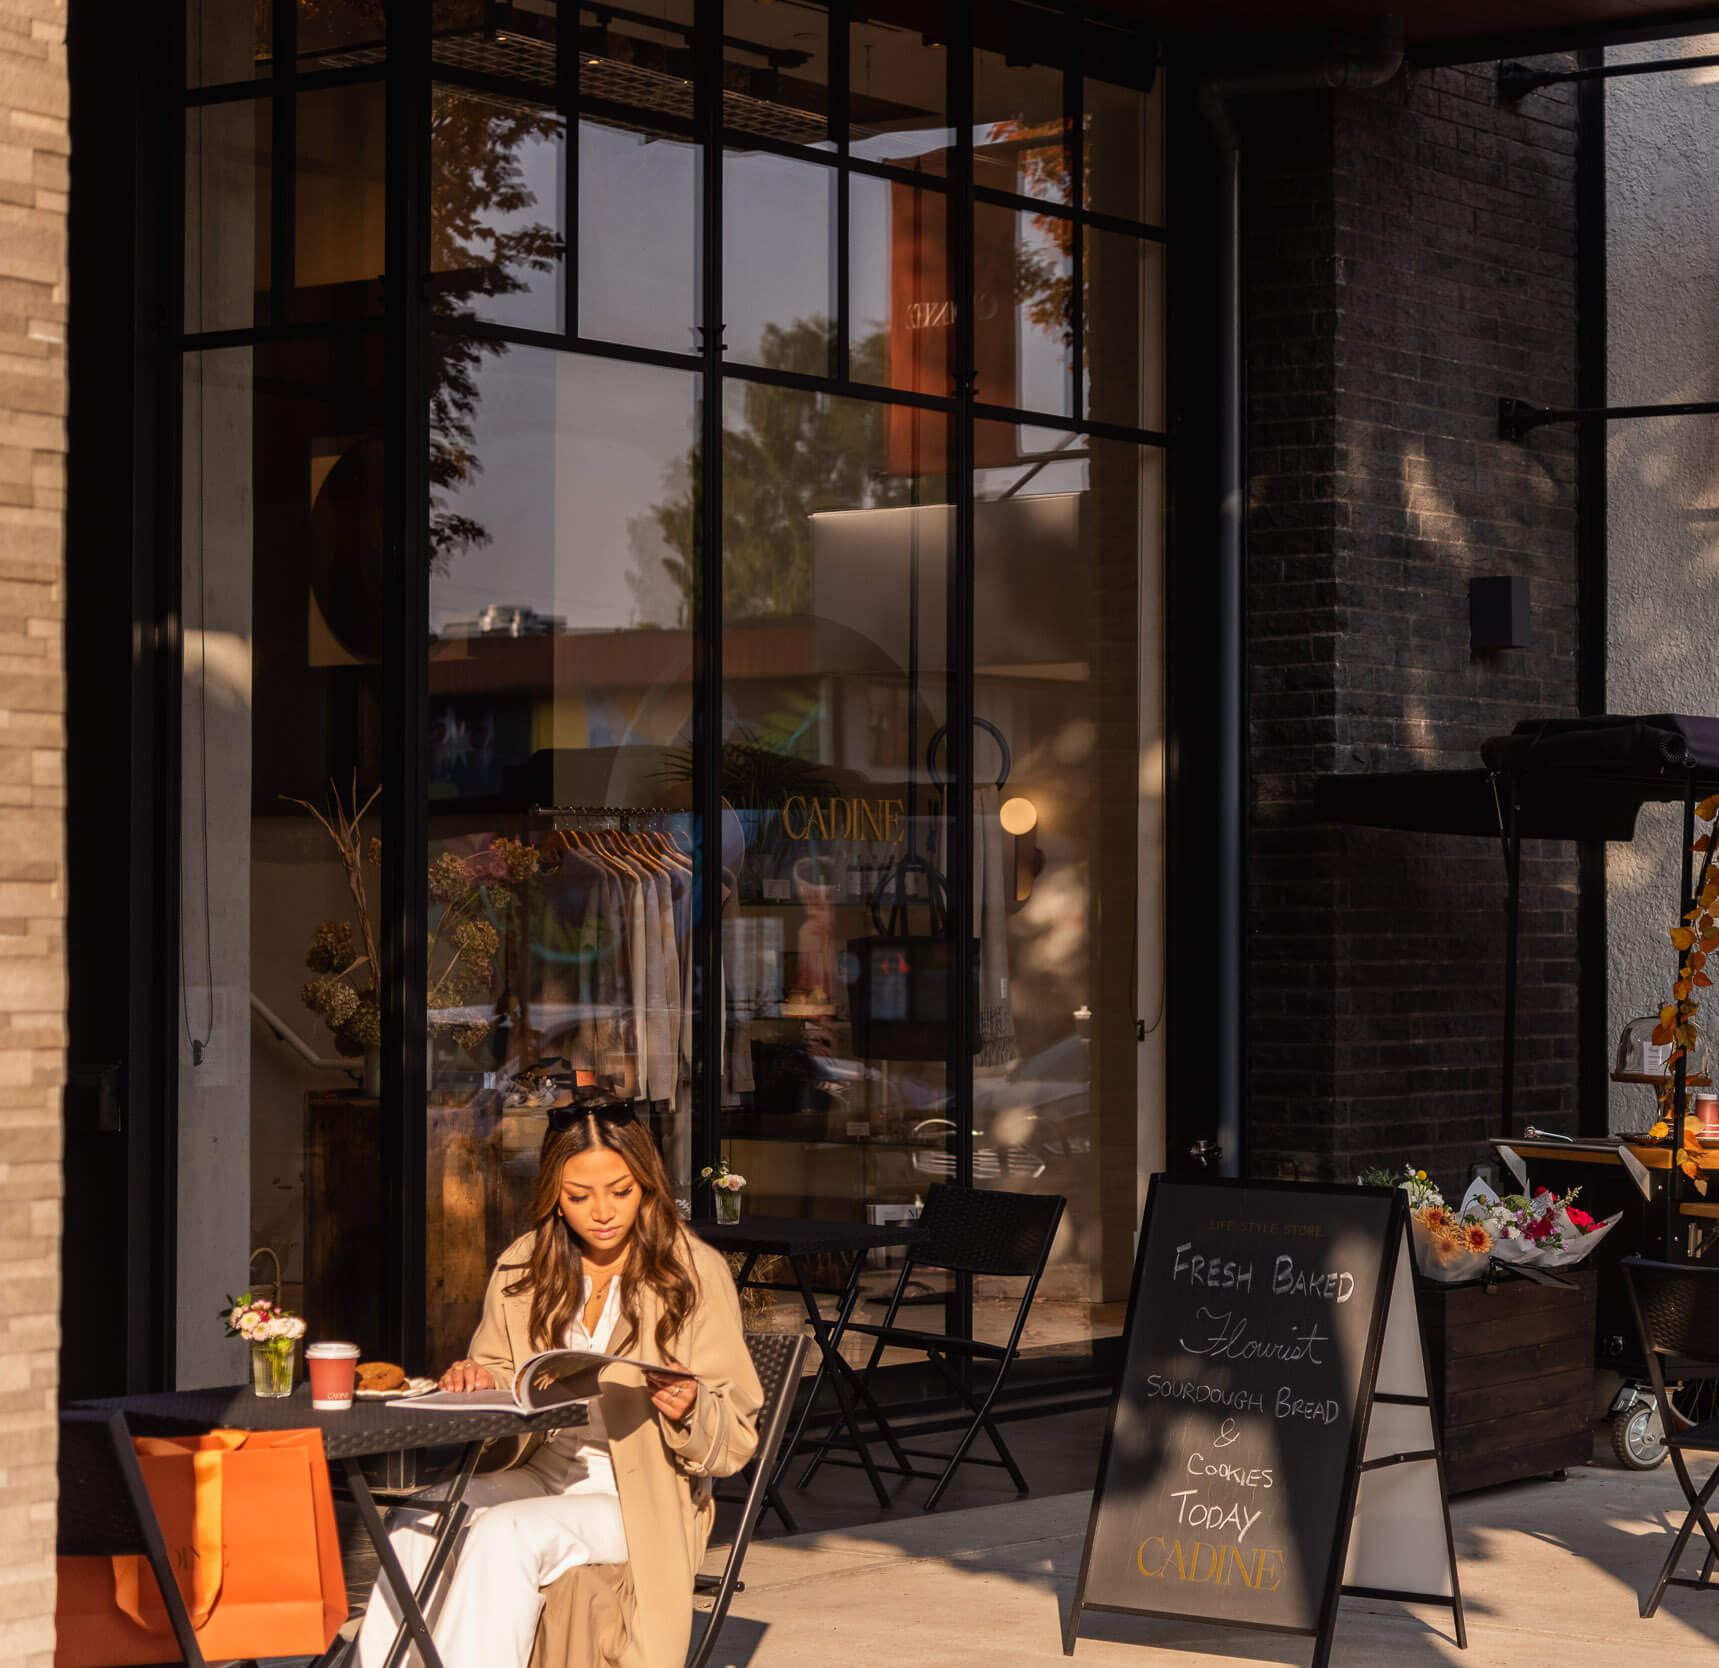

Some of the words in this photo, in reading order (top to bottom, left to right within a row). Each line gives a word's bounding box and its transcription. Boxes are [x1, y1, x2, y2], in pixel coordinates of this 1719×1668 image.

[782, 796, 905, 843] CADINE
[1173, 1242, 1253, 1294] FRESH
[1272, 1254, 1355, 1303] BAKED
[1178, 1306, 1329, 1364] Flourist
[1147, 1374, 1264, 1413] SOURDOUGH
[1274, 1386, 1340, 1425] BREAD
[1213, 1417, 1240, 1448] &
[1187, 1452, 1273, 1489] COOKIES
[1170, 1489, 1262, 1543] TODAY
[1137, 1536, 1285, 1593] CADINE
